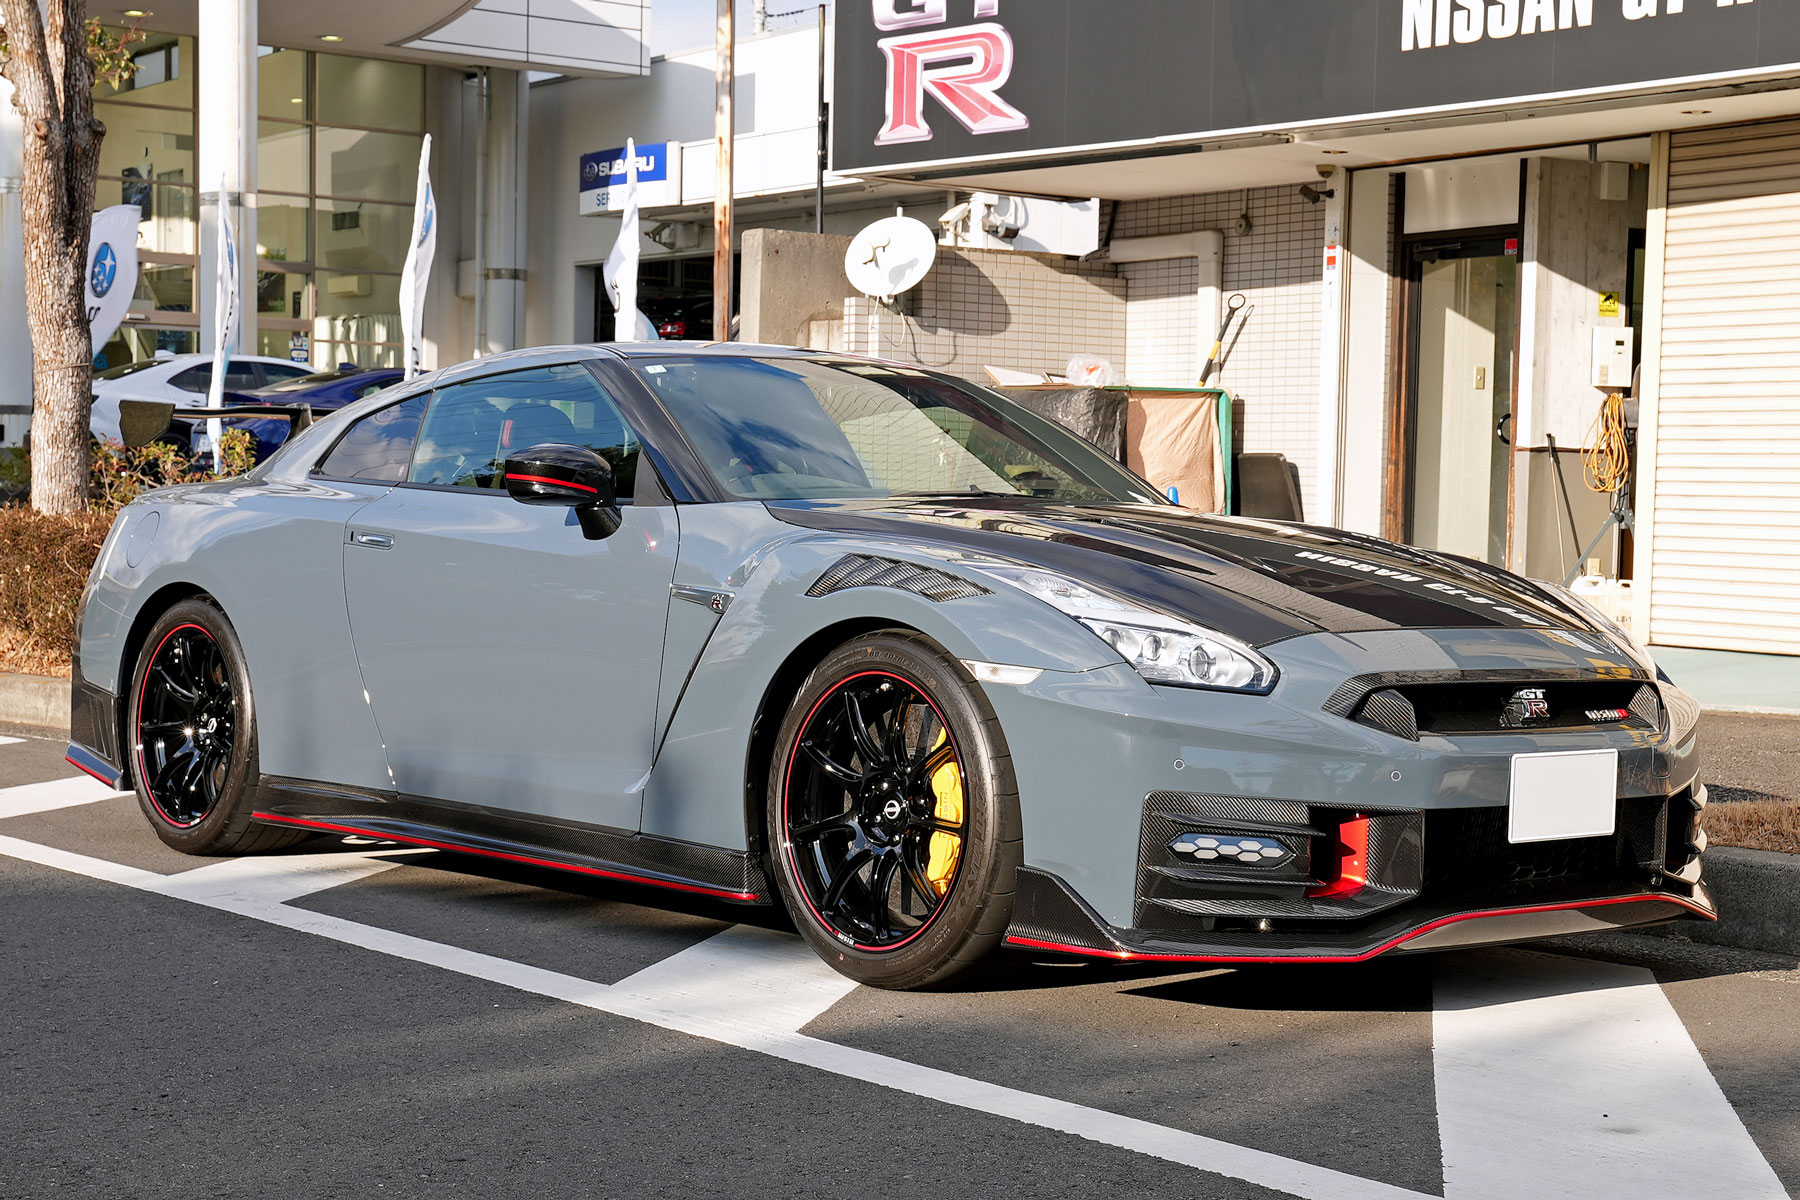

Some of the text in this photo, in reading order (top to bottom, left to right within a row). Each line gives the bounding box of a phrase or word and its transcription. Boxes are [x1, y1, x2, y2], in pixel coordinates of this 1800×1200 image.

[1401, 0, 1593, 52] NISSAN
[873, 22, 1029, 146] R
[1519, 688, 1546, 699] GT
[1526, 700, 1551, 718] R
